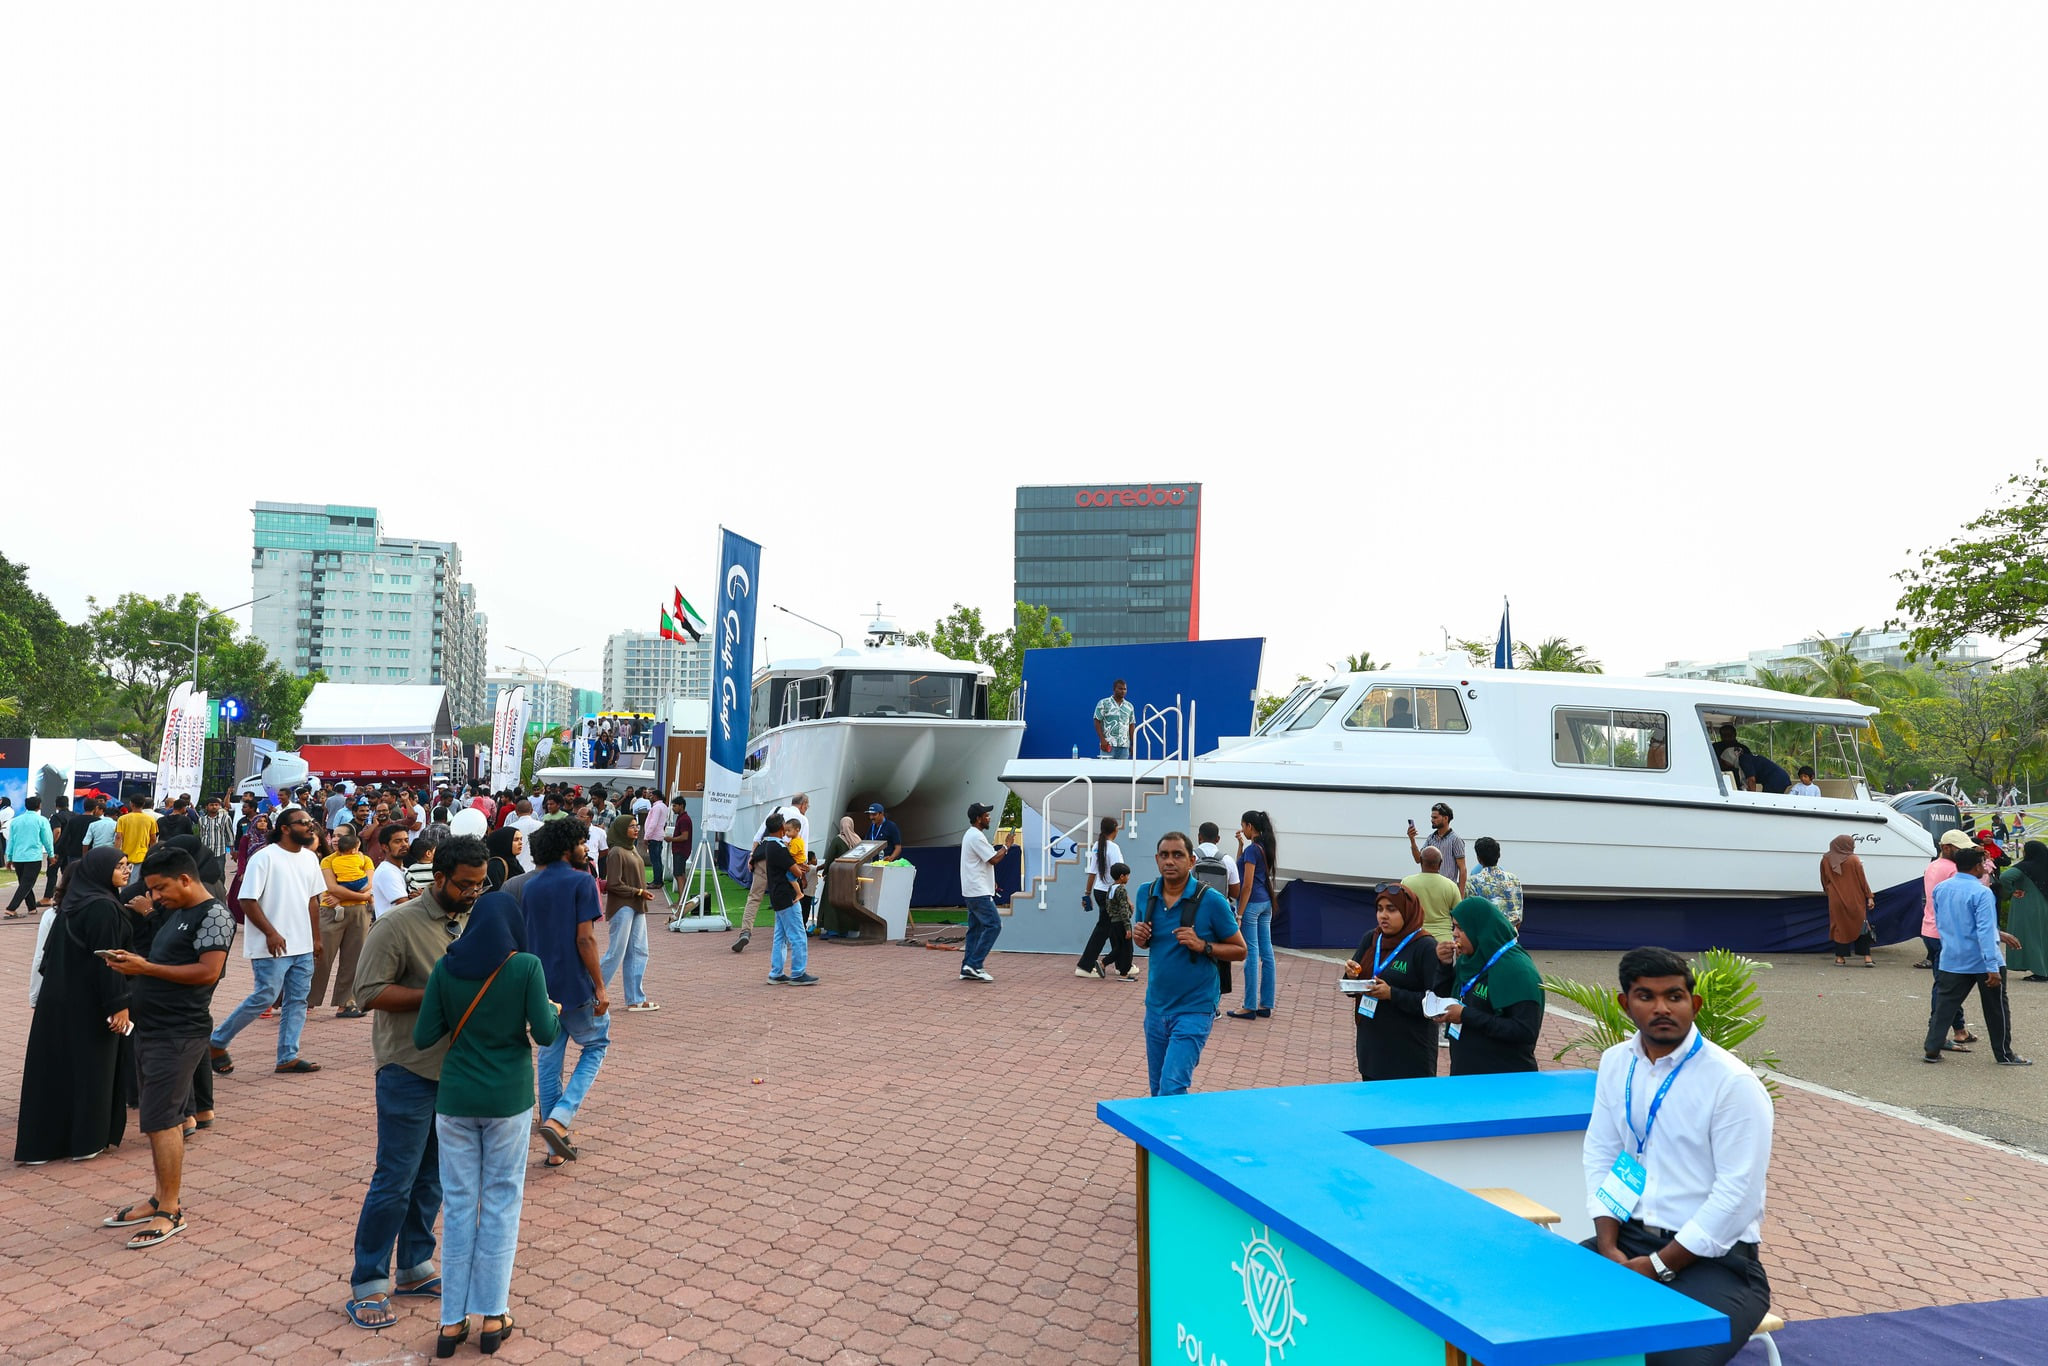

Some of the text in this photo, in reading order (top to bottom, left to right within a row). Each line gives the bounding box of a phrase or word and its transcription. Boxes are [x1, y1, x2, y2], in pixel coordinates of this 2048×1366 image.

[1076, 484, 1185, 507] ooredoo
[719, 609, 740, 741] Gulf Craft
[161, 707, 179, 762] HONDA
[1930, 813, 1956, 823] YAMAHA
